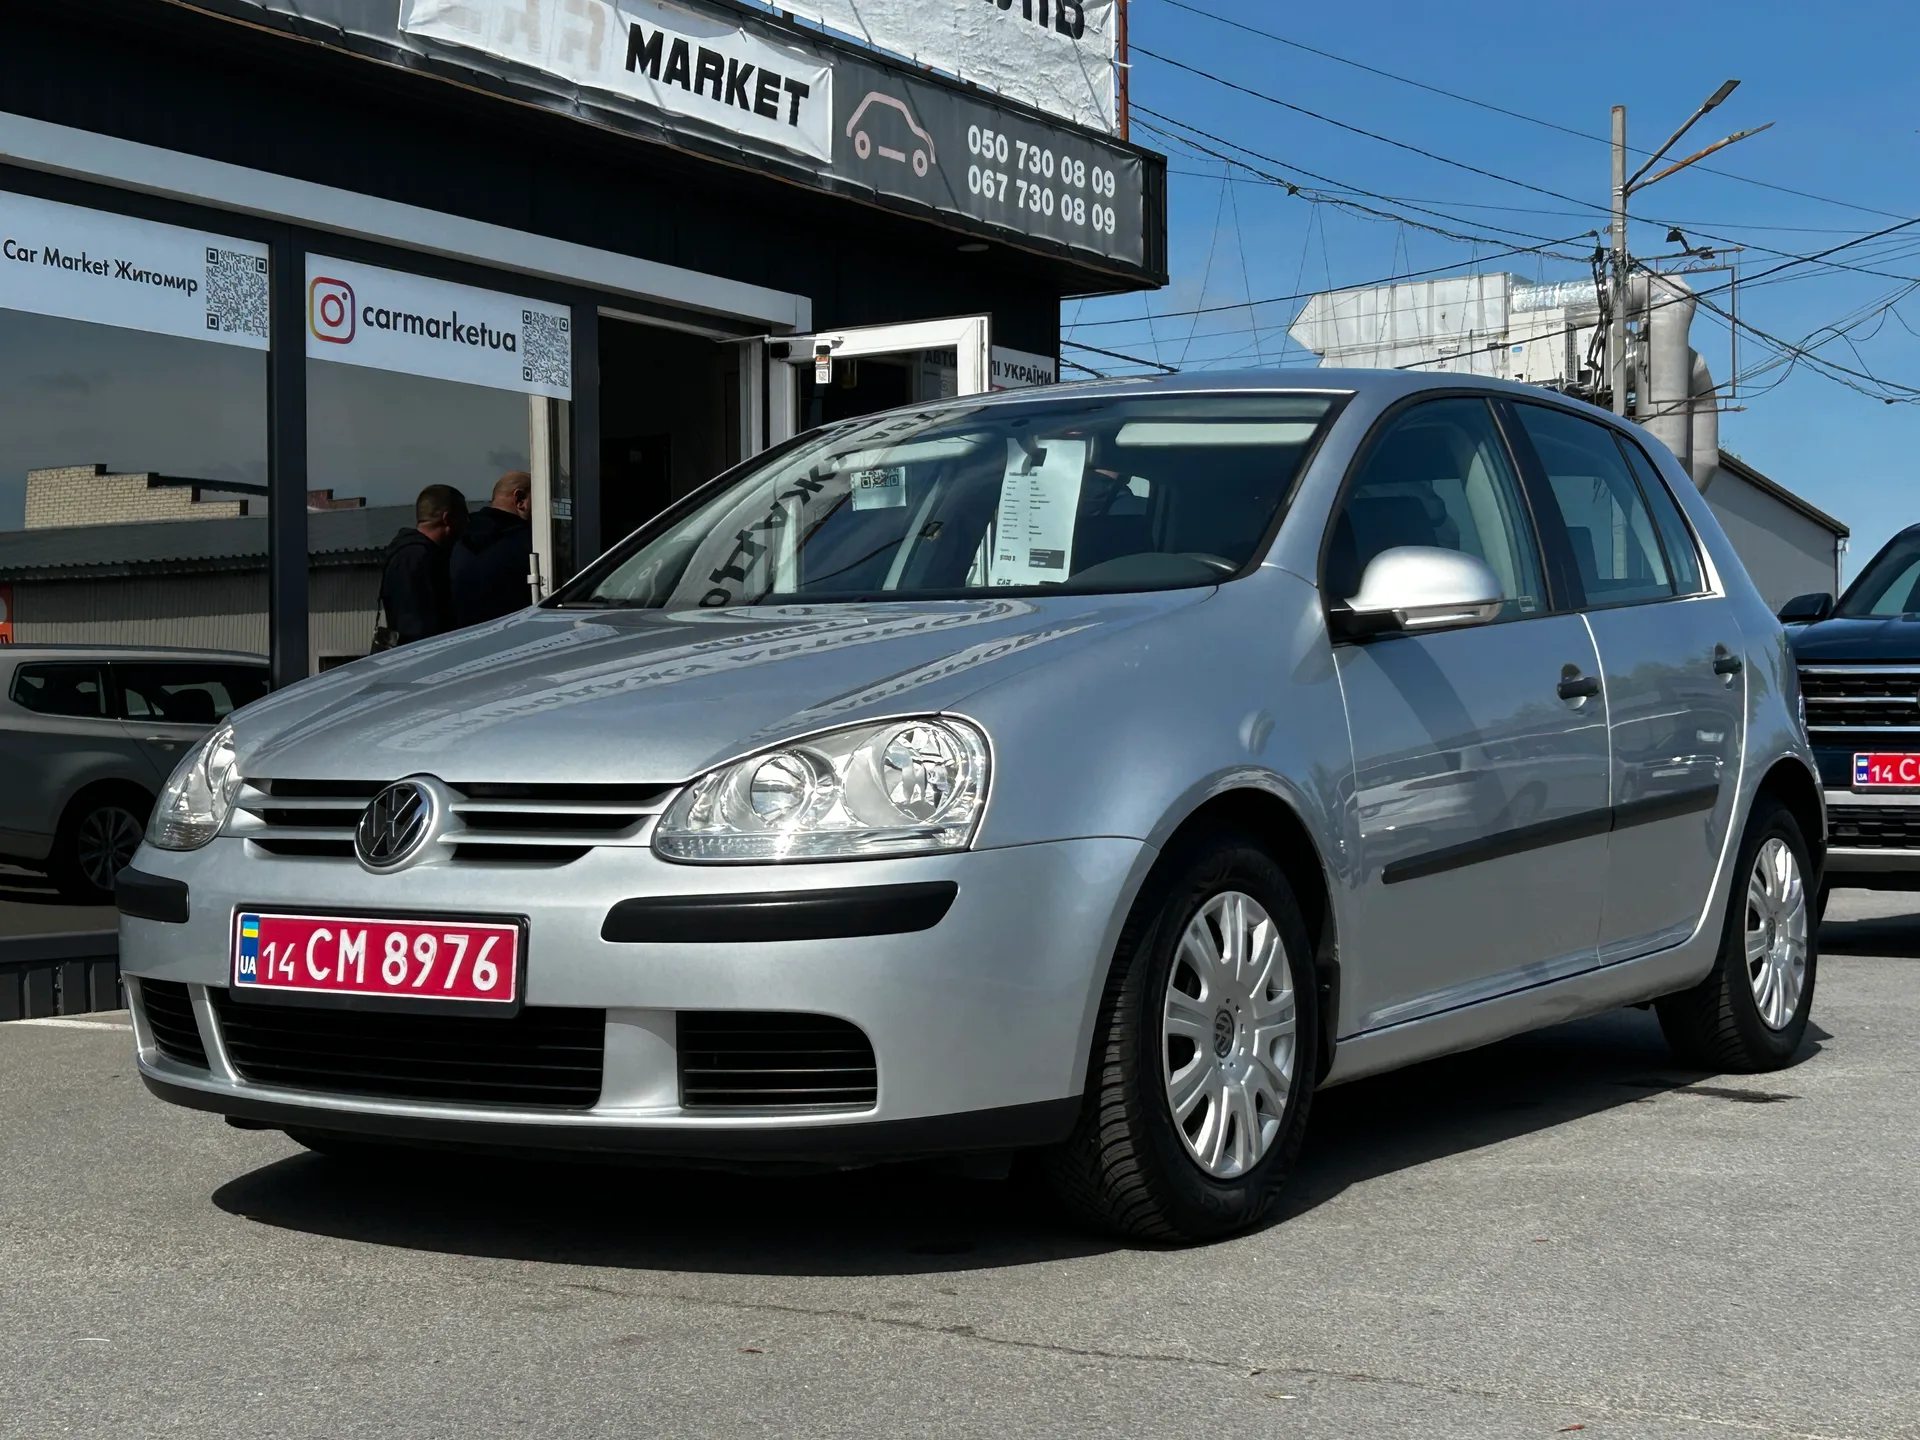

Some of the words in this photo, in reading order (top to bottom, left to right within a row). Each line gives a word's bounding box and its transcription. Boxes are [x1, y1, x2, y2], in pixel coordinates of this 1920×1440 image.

[625, 22, 810, 127] MARKET
[968, 124, 1008, 164] 050
[1016, 140, 1054, 178] 730
[1061, 155, 1085, 188] 08
[1092, 166, 1115, 198] 09
[968, 165, 1008, 202] 067
[1016, 179, 1054, 216] 730
[1061, 194, 1085, 225] 08
[1092, 203, 1116, 234] 09
[3, 239, 38, 263] Car
[43, 247, 110, 276] Market
[114, 259, 198, 297] Житомир
[362, 306, 517, 352] carmarketua
[1004, 362, 1052, 385] УКРАЇНИ
[1871, 765, 1893, 782] 14
[1899, 758, 1920, 781] C
[240, 955, 257, 975] UA
[262, 942, 296, 981] 14
[305, 928, 368, 984] CM
[381, 931, 500, 991] 8976
